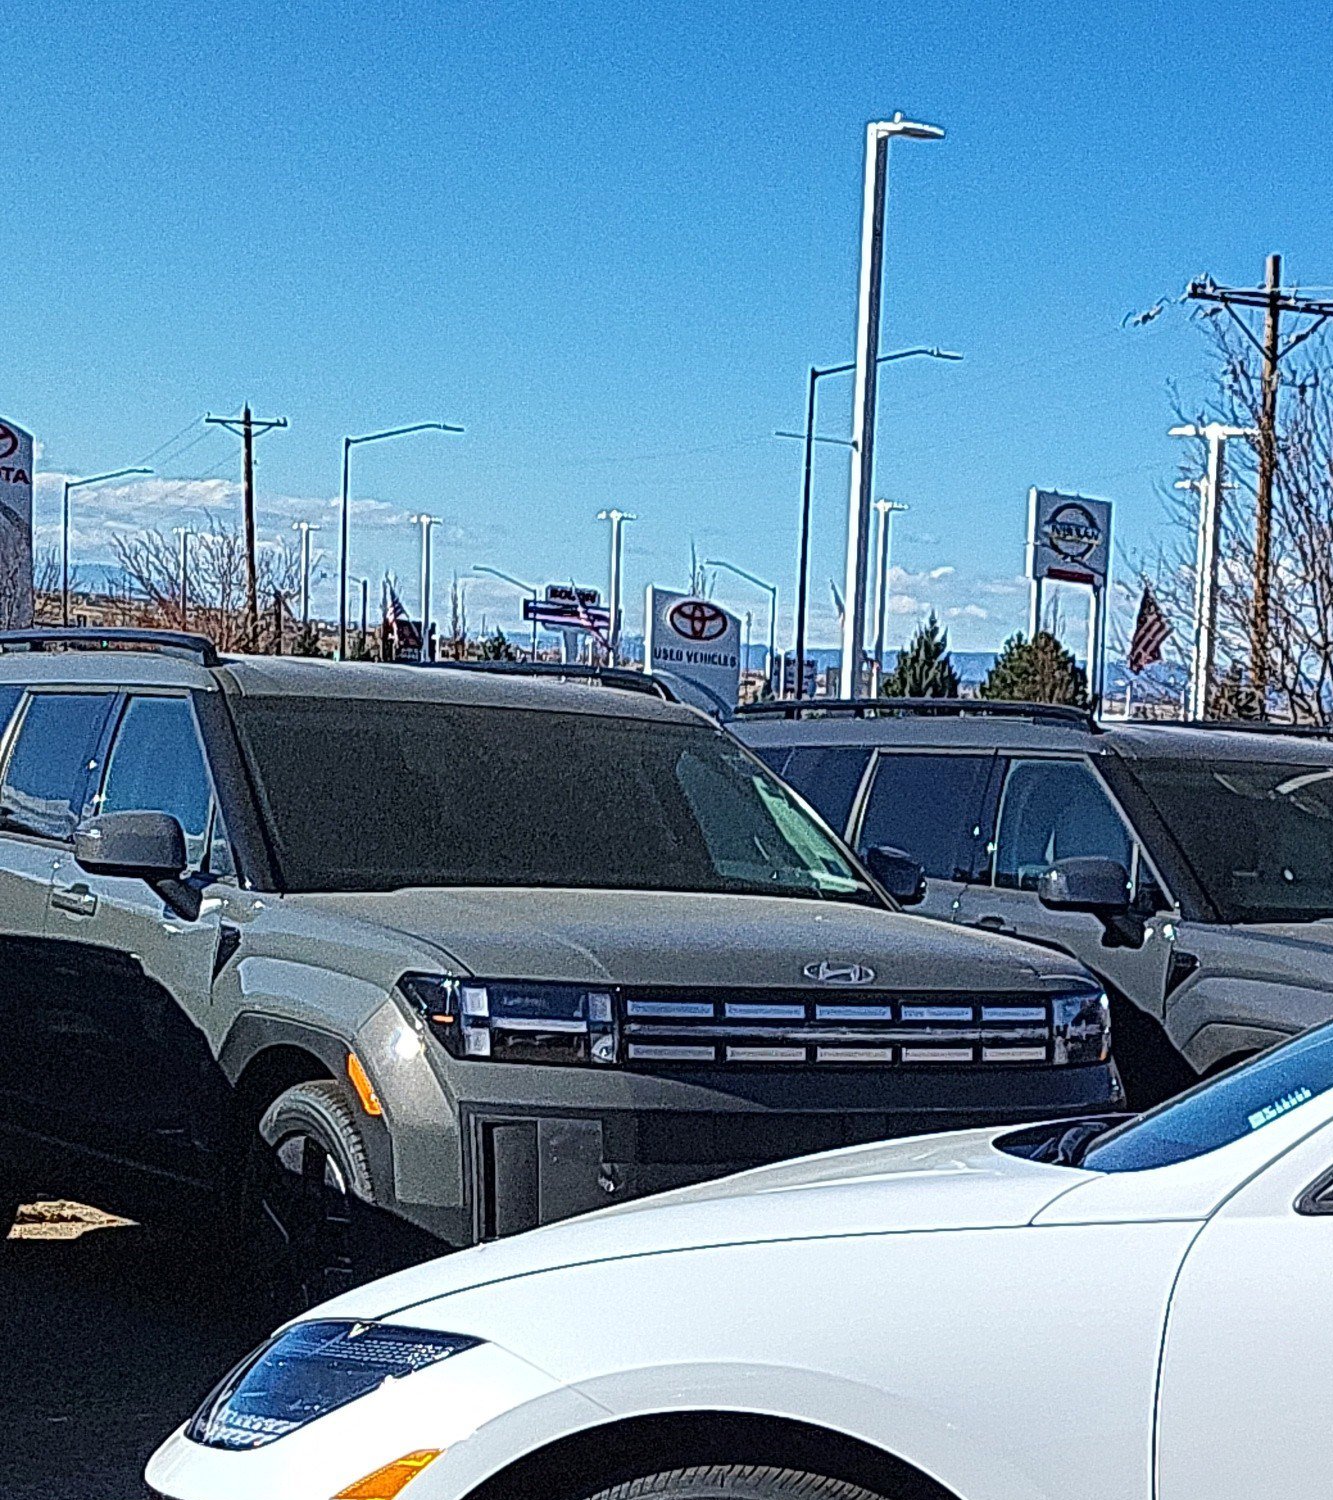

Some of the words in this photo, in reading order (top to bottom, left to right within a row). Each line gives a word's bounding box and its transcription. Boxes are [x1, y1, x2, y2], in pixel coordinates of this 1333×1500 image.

[0, 466, 31, 485] TA
[653, 646, 683, 662] USED
[686, 650, 737, 669] VEHICLES
